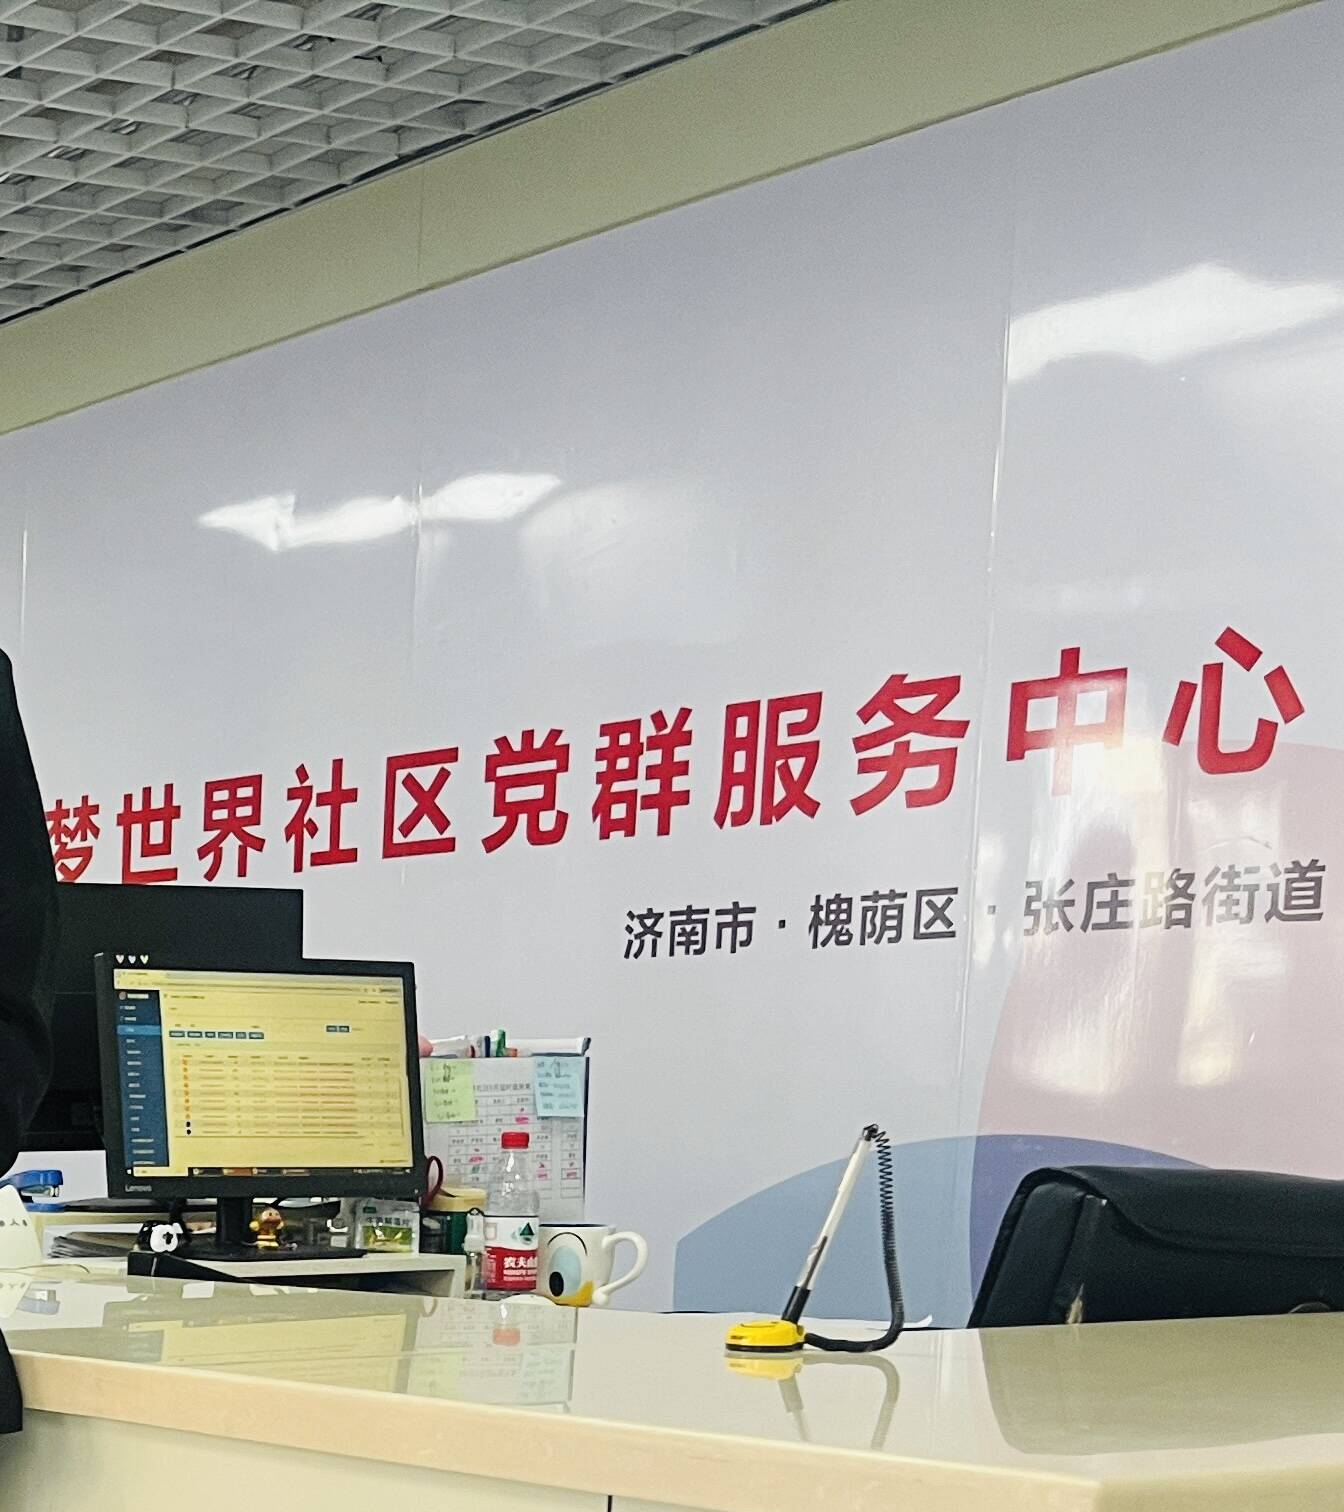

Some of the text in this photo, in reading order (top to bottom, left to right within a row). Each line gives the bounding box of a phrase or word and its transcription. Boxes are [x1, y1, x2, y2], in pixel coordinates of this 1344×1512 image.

[45, 626, 1305, 884] 梦世界社区党群服务中心
